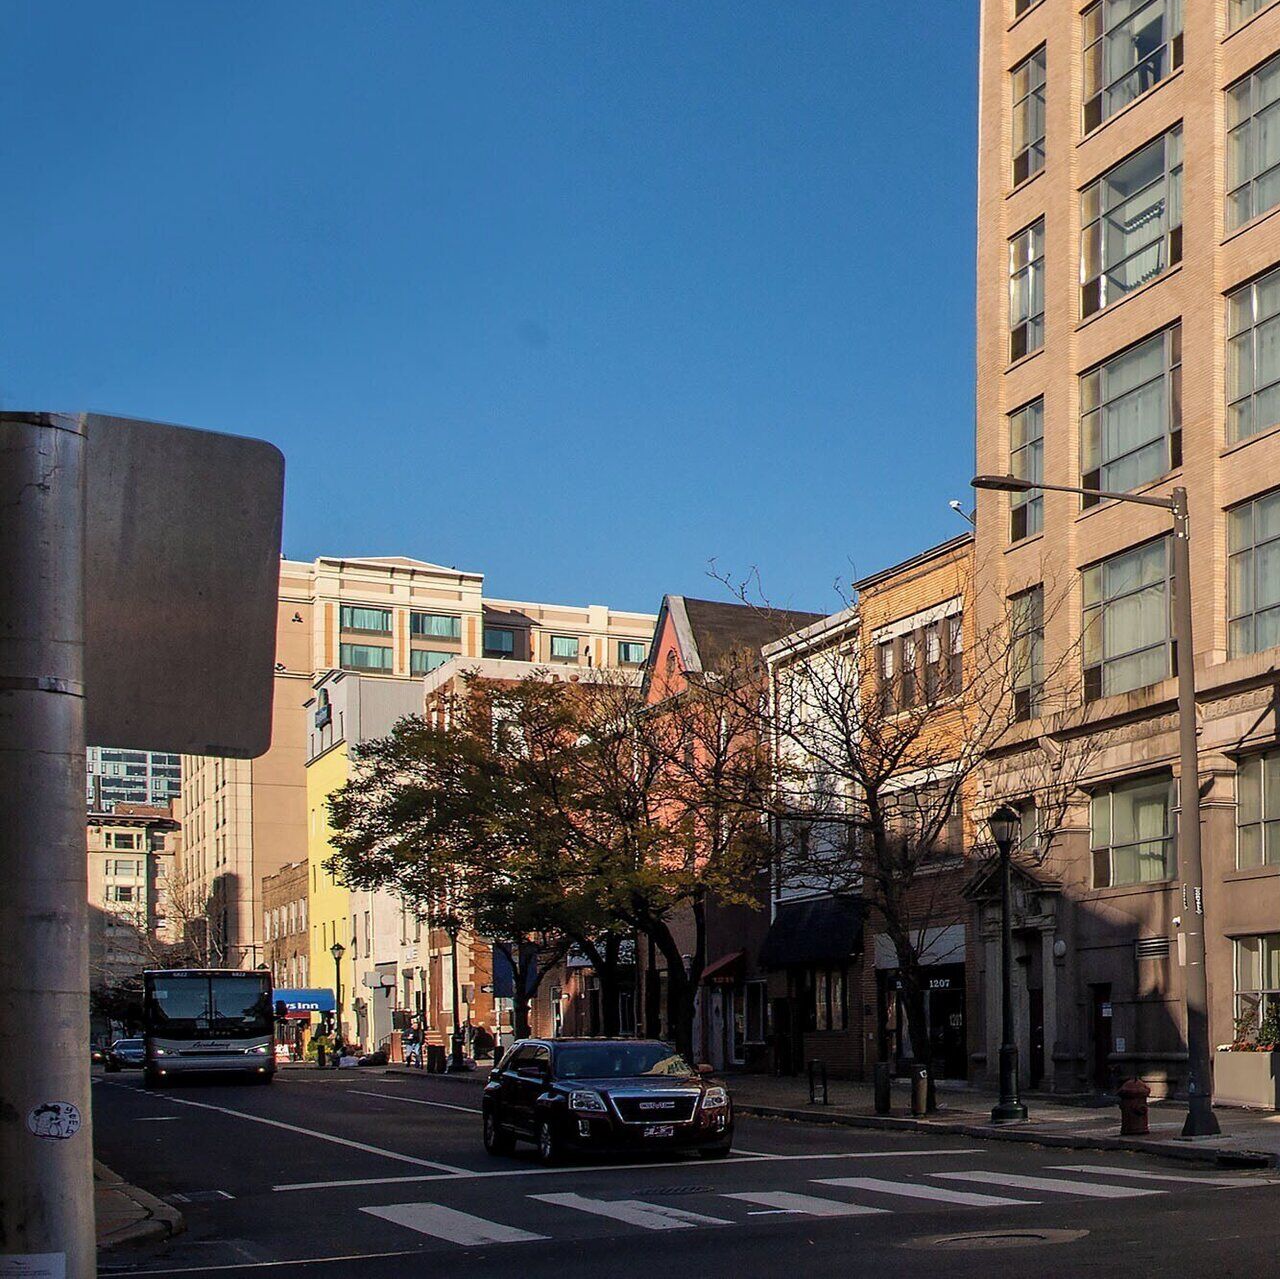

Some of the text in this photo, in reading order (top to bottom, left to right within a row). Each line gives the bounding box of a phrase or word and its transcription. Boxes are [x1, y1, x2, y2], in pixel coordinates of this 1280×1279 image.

[929, 979, 950, 988] 1207
[298, 1002, 319, 1010] Inn
[639, 1101, 676, 1109] GMC
